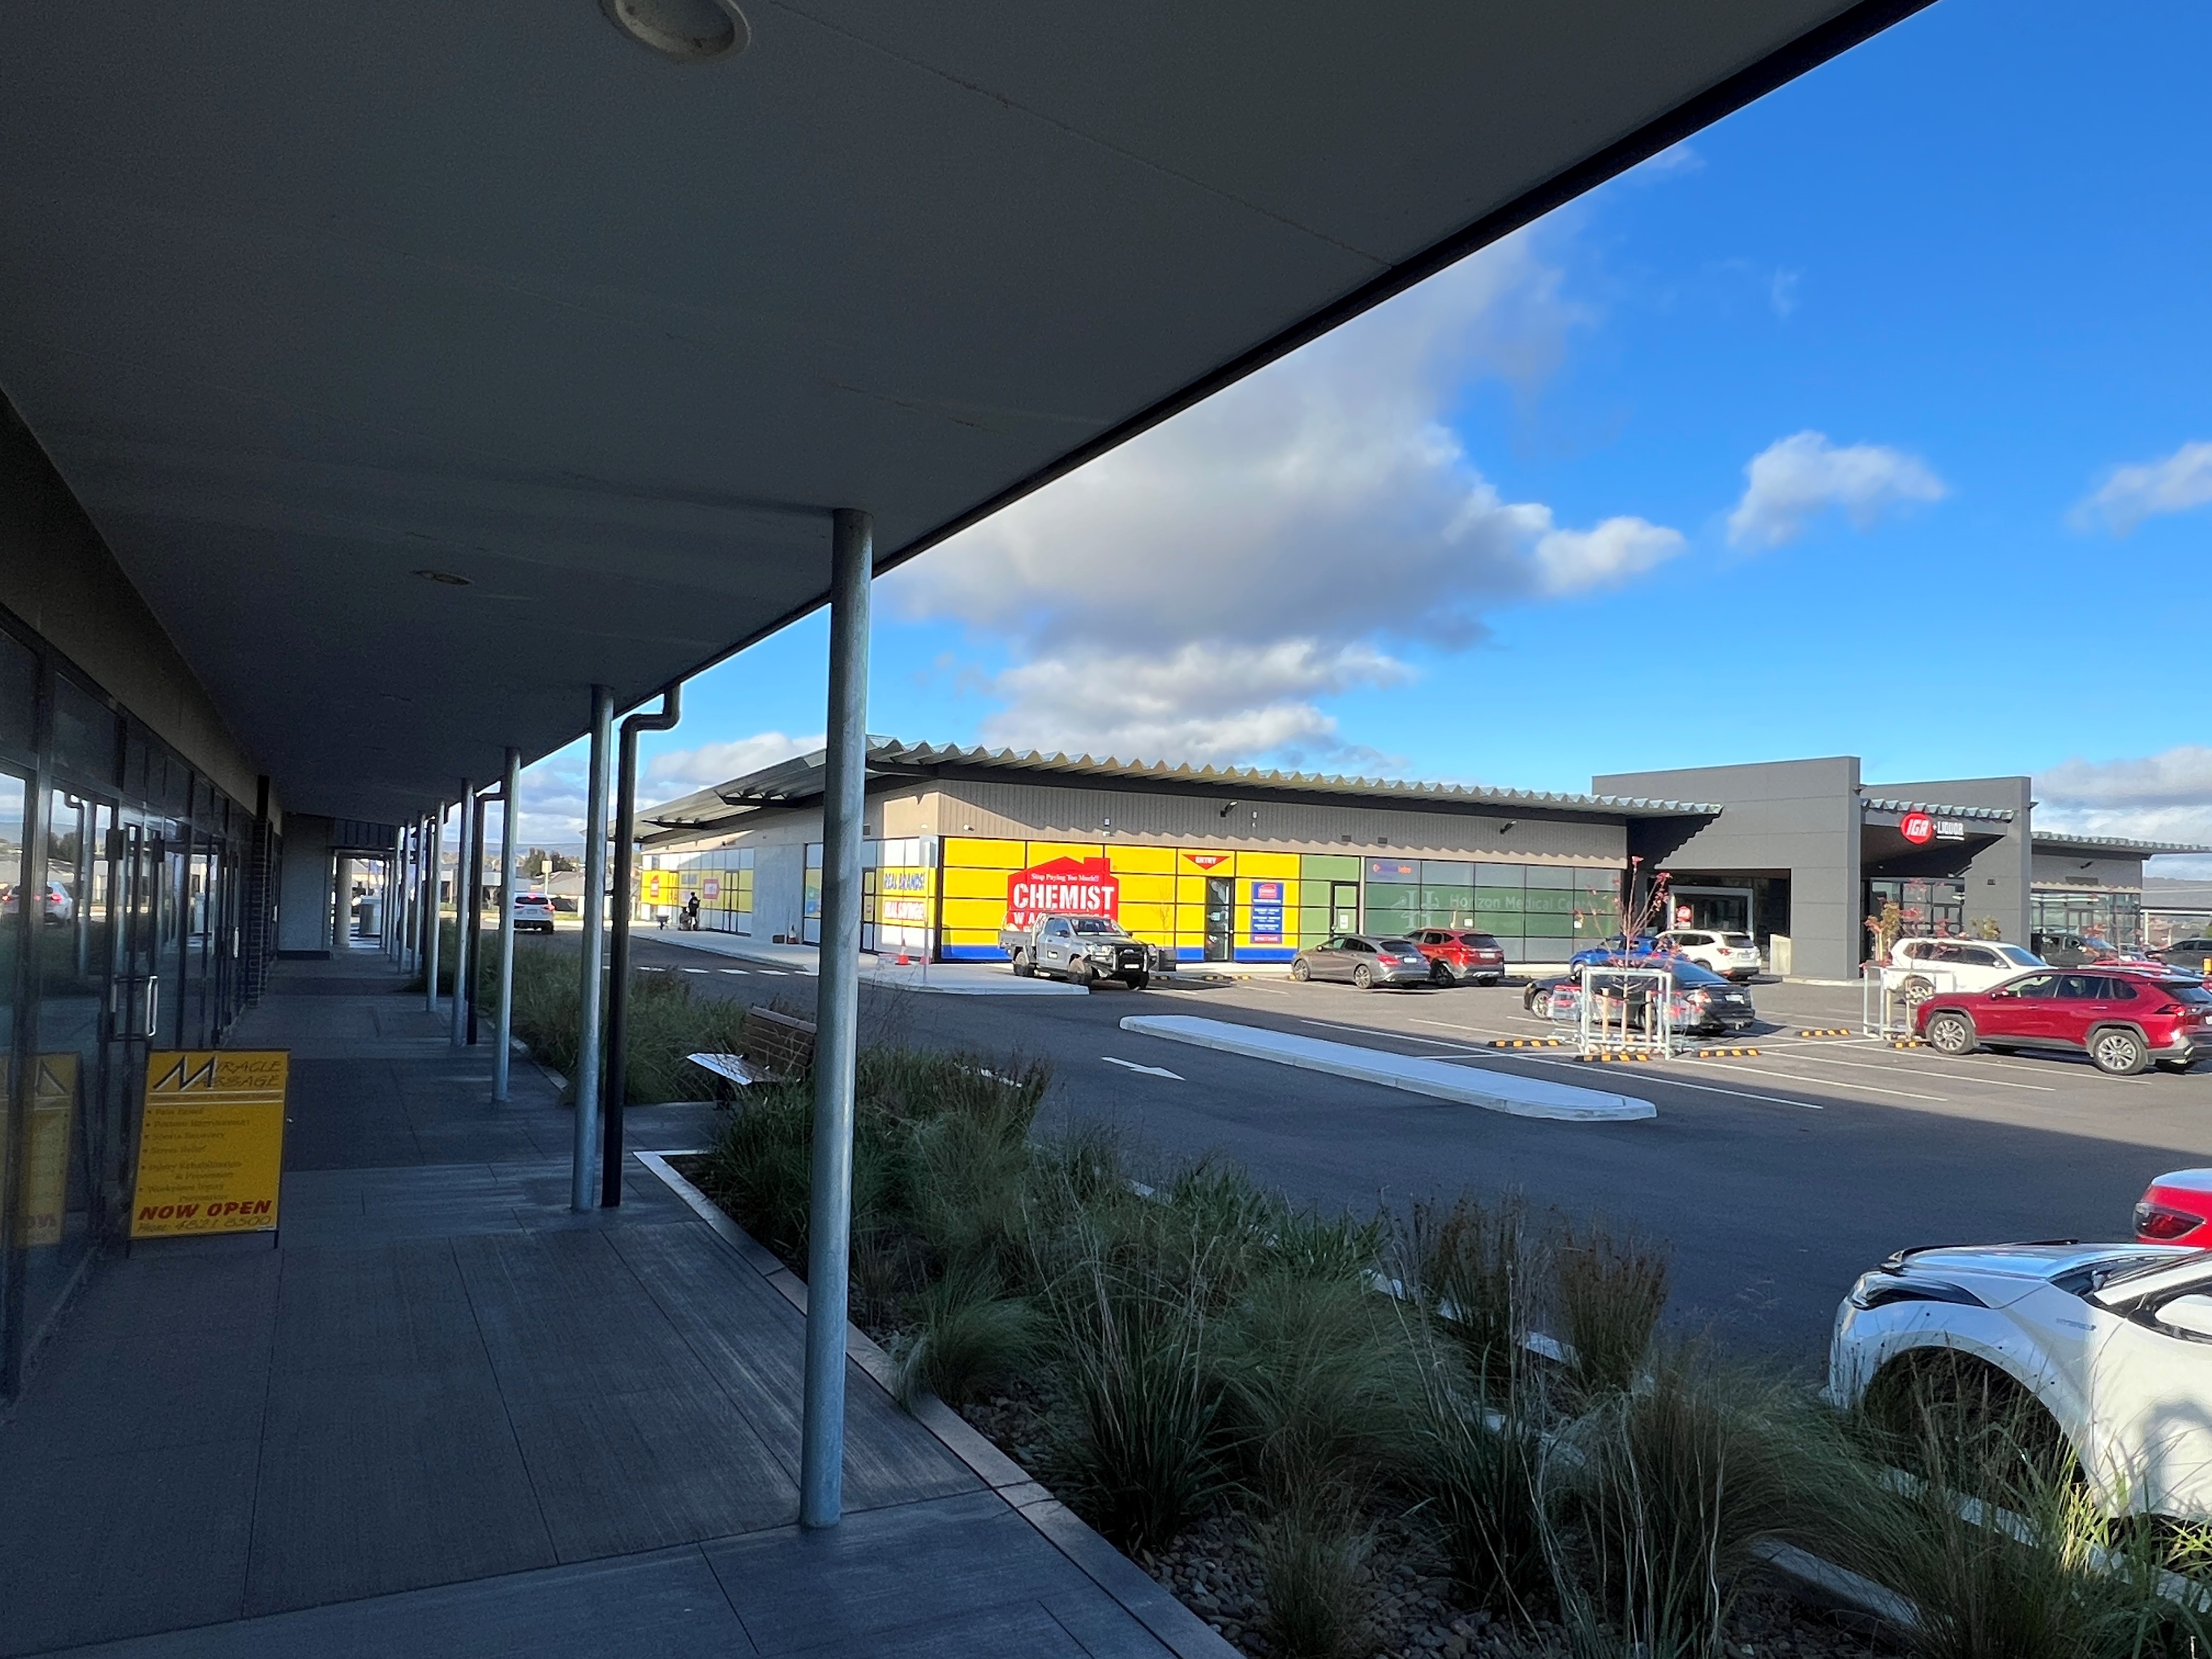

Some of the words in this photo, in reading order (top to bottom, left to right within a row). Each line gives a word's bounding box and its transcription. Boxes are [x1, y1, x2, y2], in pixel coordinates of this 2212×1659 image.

[1906, 819, 1929, 836] IGA
[1195, 856, 1217, 864] ENTRY
[1046, 873, 1066, 882] Paying
[1013, 883, 1115, 910] CHEMIST
[1450, 894, 1500, 909] Horizon
[1506, 896, 1553, 910] Medical
[138, 1204, 200, 1220] NOW
[207, 1200, 272, 1217] OPEN
